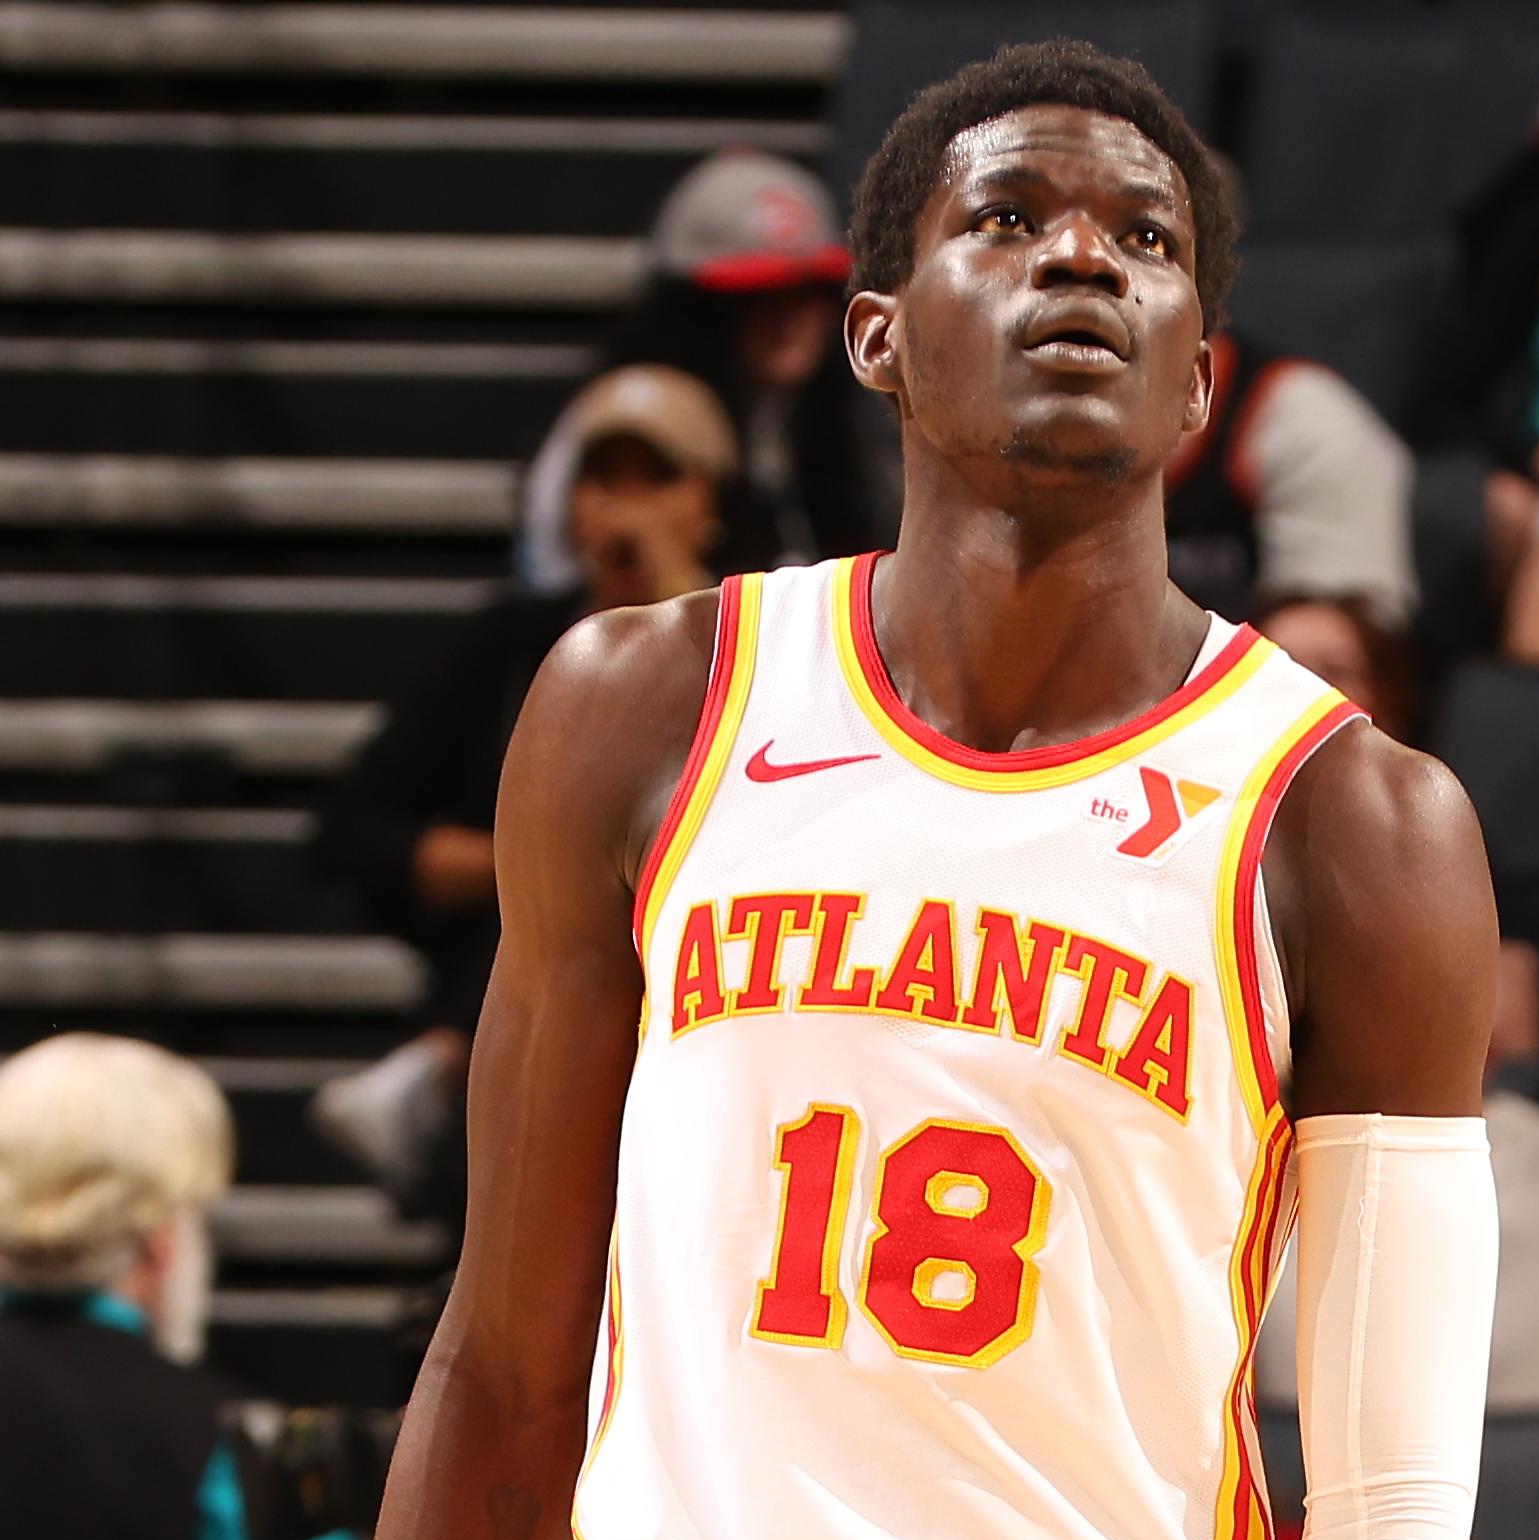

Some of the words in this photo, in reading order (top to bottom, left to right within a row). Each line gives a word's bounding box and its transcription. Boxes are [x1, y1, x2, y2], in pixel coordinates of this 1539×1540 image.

[1090, 797, 1129, 823] the
[671, 890, 1195, 1126] ATLANTA
[749, 1101, 1053, 1370] 18
